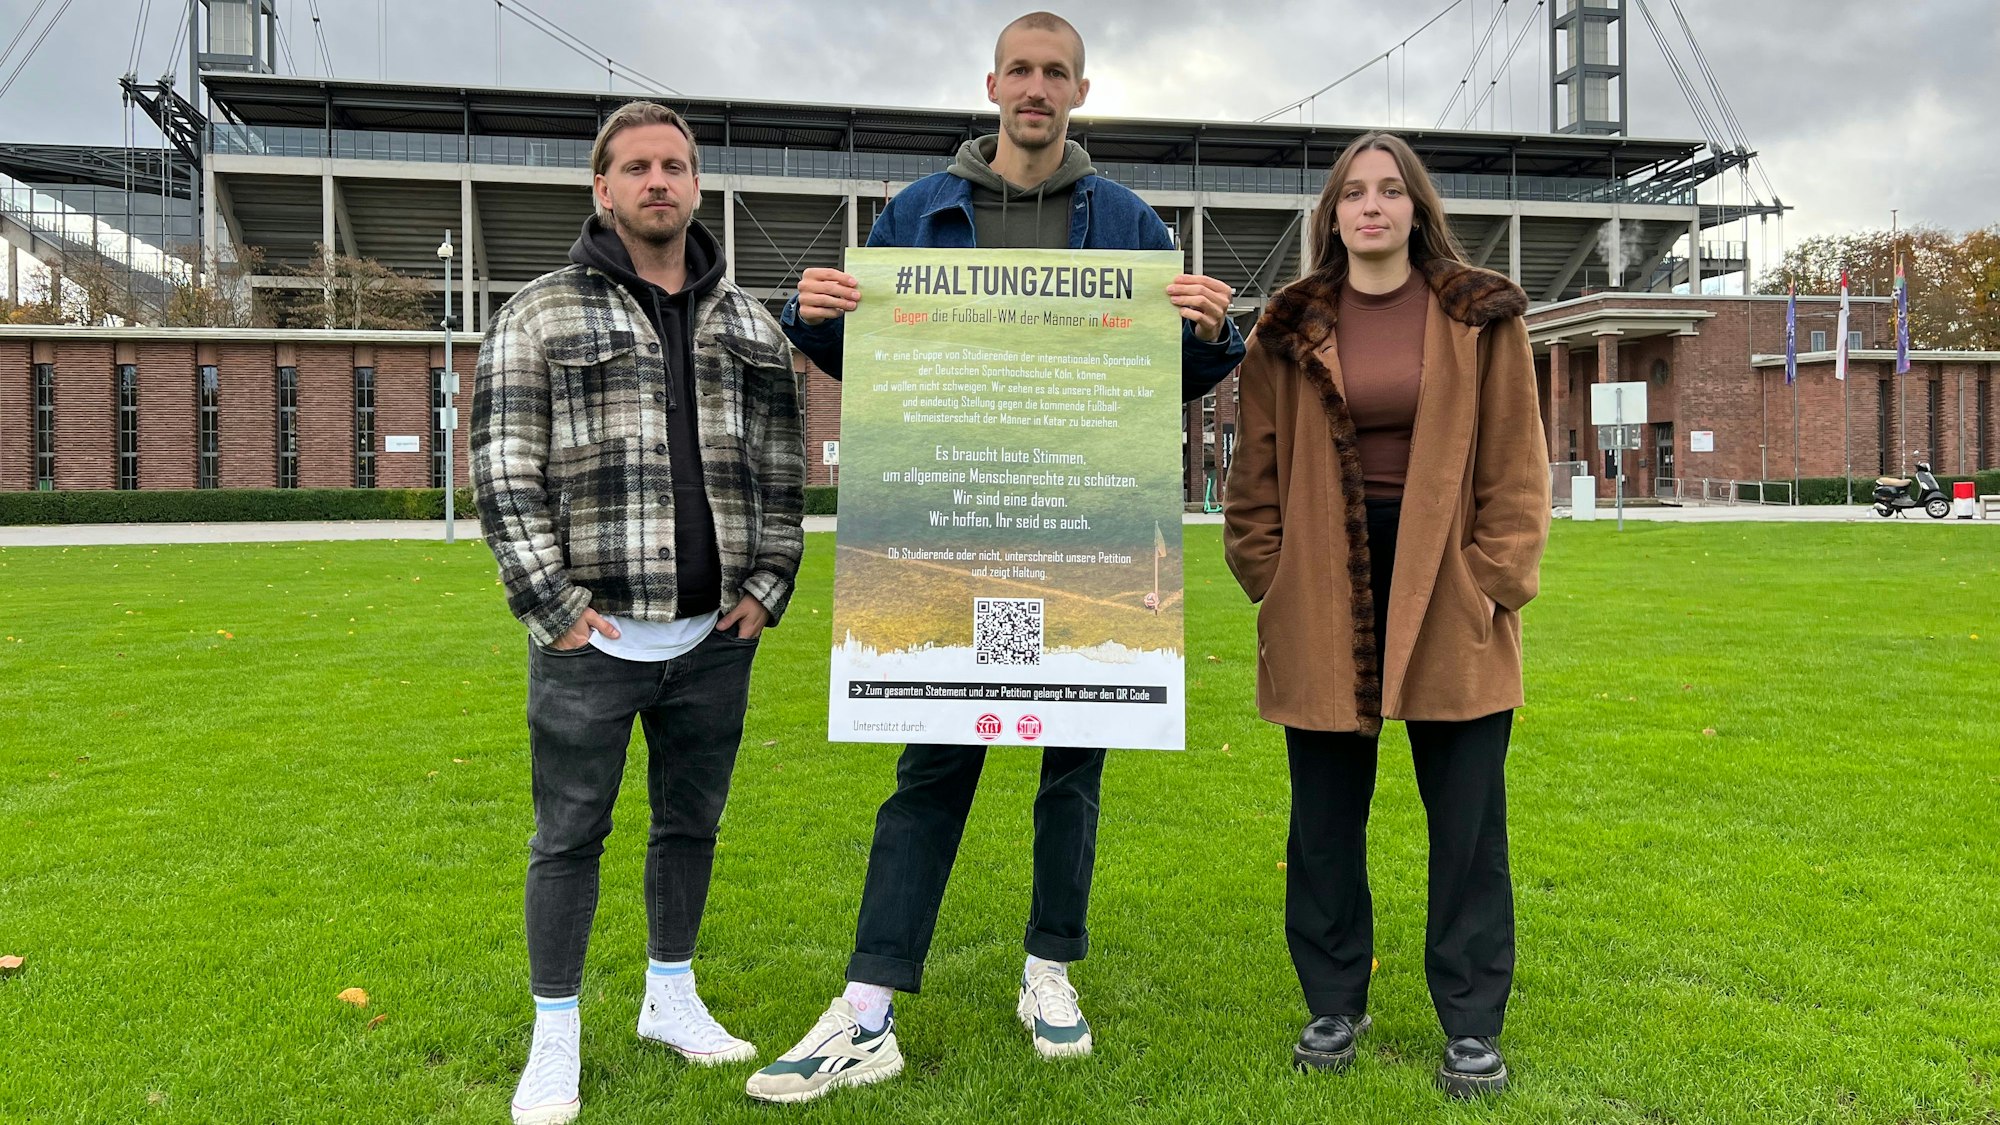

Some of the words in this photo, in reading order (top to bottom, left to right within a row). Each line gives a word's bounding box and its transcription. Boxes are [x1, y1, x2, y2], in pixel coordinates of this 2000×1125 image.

[896, 265, 1133, 299] #HALTUNGZEIGEN
[894, 308, 928, 325] Gegen
[932, 308, 948, 322] die
[952, 308, 1016, 323] Fußball-WM
[1020, 310, 1039, 324] der
[1043, 311, 1085, 326] Männer
[1089, 314, 1098, 327] in
[1102, 313, 1132, 328] Katar
[893, 351, 911, 361] eine
[913, 349, 942, 361] Gruppe
[945, 351, 960, 360] von
[962, 348, 1018, 362] Studierenden
[1020, 351, 1035, 362] der
[1037, 353, 1100, 365] internationalen
[1103, 354, 1151, 367] Sportpolitik
[918, 365, 933, 376] der
[935, 364, 979, 376] Deutschen
[981, 364, 1052, 378] Sporthochschule
[1076, 369, 1106, 380] können
[873, 381, 888, 392] und
[891, 381, 917, 392] wollen
[919, 381, 940, 391] nicht
[942, 380, 989, 393] schweigen.
[991, 381, 1005, 392] Wir
[1008, 382, 1033, 393] sehen
[1035, 386, 1045, 394] es
[1047, 384, 1060, 395] als
[1062, 386, 1091, 396] unsere
[1093, 384, 1120, 397] Pflicht
[1137, 386, 1154, 398] klar
[903, 396, 918, 407] und
[920, 396, 959, 409] eindeutig
[961, 396, 995, 410] Stellung
[997, 399, 1023, 411] gegen
[1025, 399, 1037, 410] die
[1040, 399, 1085, 411] kommende
[1087, 400, 1121, 412] Fußball-
[903, 411, 981, 423] Weltmeisterschaft
[983, 413, 997, 424] der
[1000, 413, 1031, 425] Männer
[1033, 415, 1041, 425] in
[1043, 414, 1066, 426] Katar
[1069, 418, 1078, 426] zu
[1081, 416, 1120, 428] beziehen.
[935, 445, 949, 461] Es
[952, 445, 998, 462] braucht
[1001, 447, 1029, 463] laute
[1033, 448, 1087, 465] Stimmen,
[882, 471, 901, 482] um
[904, 467, 966, 485] allgemeine
[969, 467, 1064, 486] Menschenrechte
[1067, 476, 1080, 486] zu
[1084, 472, 1138, 487] schützen.
[953, 489, 973, 505] Wir
[976, 490, 1000, 506] sind
[1003, 492, 1027, 507] eine
[1031, 492, 1068, 508] davon.
[929, 510, 949, 527] Wir
[952, 511, 992, 528] hoffen,
[996, 512, 1013, 528] Ihr
[1016, 513, 1040, 529] seid
[1043, 519, 1056, 529] es
[1060, 515, 1091, 530] auch.
[888, 547, 899, 559] Ob
[902, 547, 954, 560] Studierende
[956, 549, 977, 560] oder
[1005, 550, 1064, 562] unterschreibt
[1066, 553, 1096, 563] unsere
[1098, 551, 1131, 564] Petition
[971, 565, 987, 577] und
[990, 567, 1010, 579] zeigt
[1012, 566, 1048, 580] Haltung.
[865, 684, 882, 696] Zum
[884, 685, 923, 698] gesamten
[925, 684, 967, 697] Statement
[969, 686, 984, 697] und
[985, 688, 999, 698] zur
[1000, 686, 1032, 699] Petition
[1033, 687, 1063, 701] gelangt
[1065, 687, 1077, 699] Ihr
[1079, 688, 1098, 699] über
[1099, 688, 1114, 700] den
[1116, 688, 1128, 700] QR
[1129, 688, 1150, 701] Code
[853, 720, 899, 731] Unterstützt
[901, 721, 927, 732] durch:
